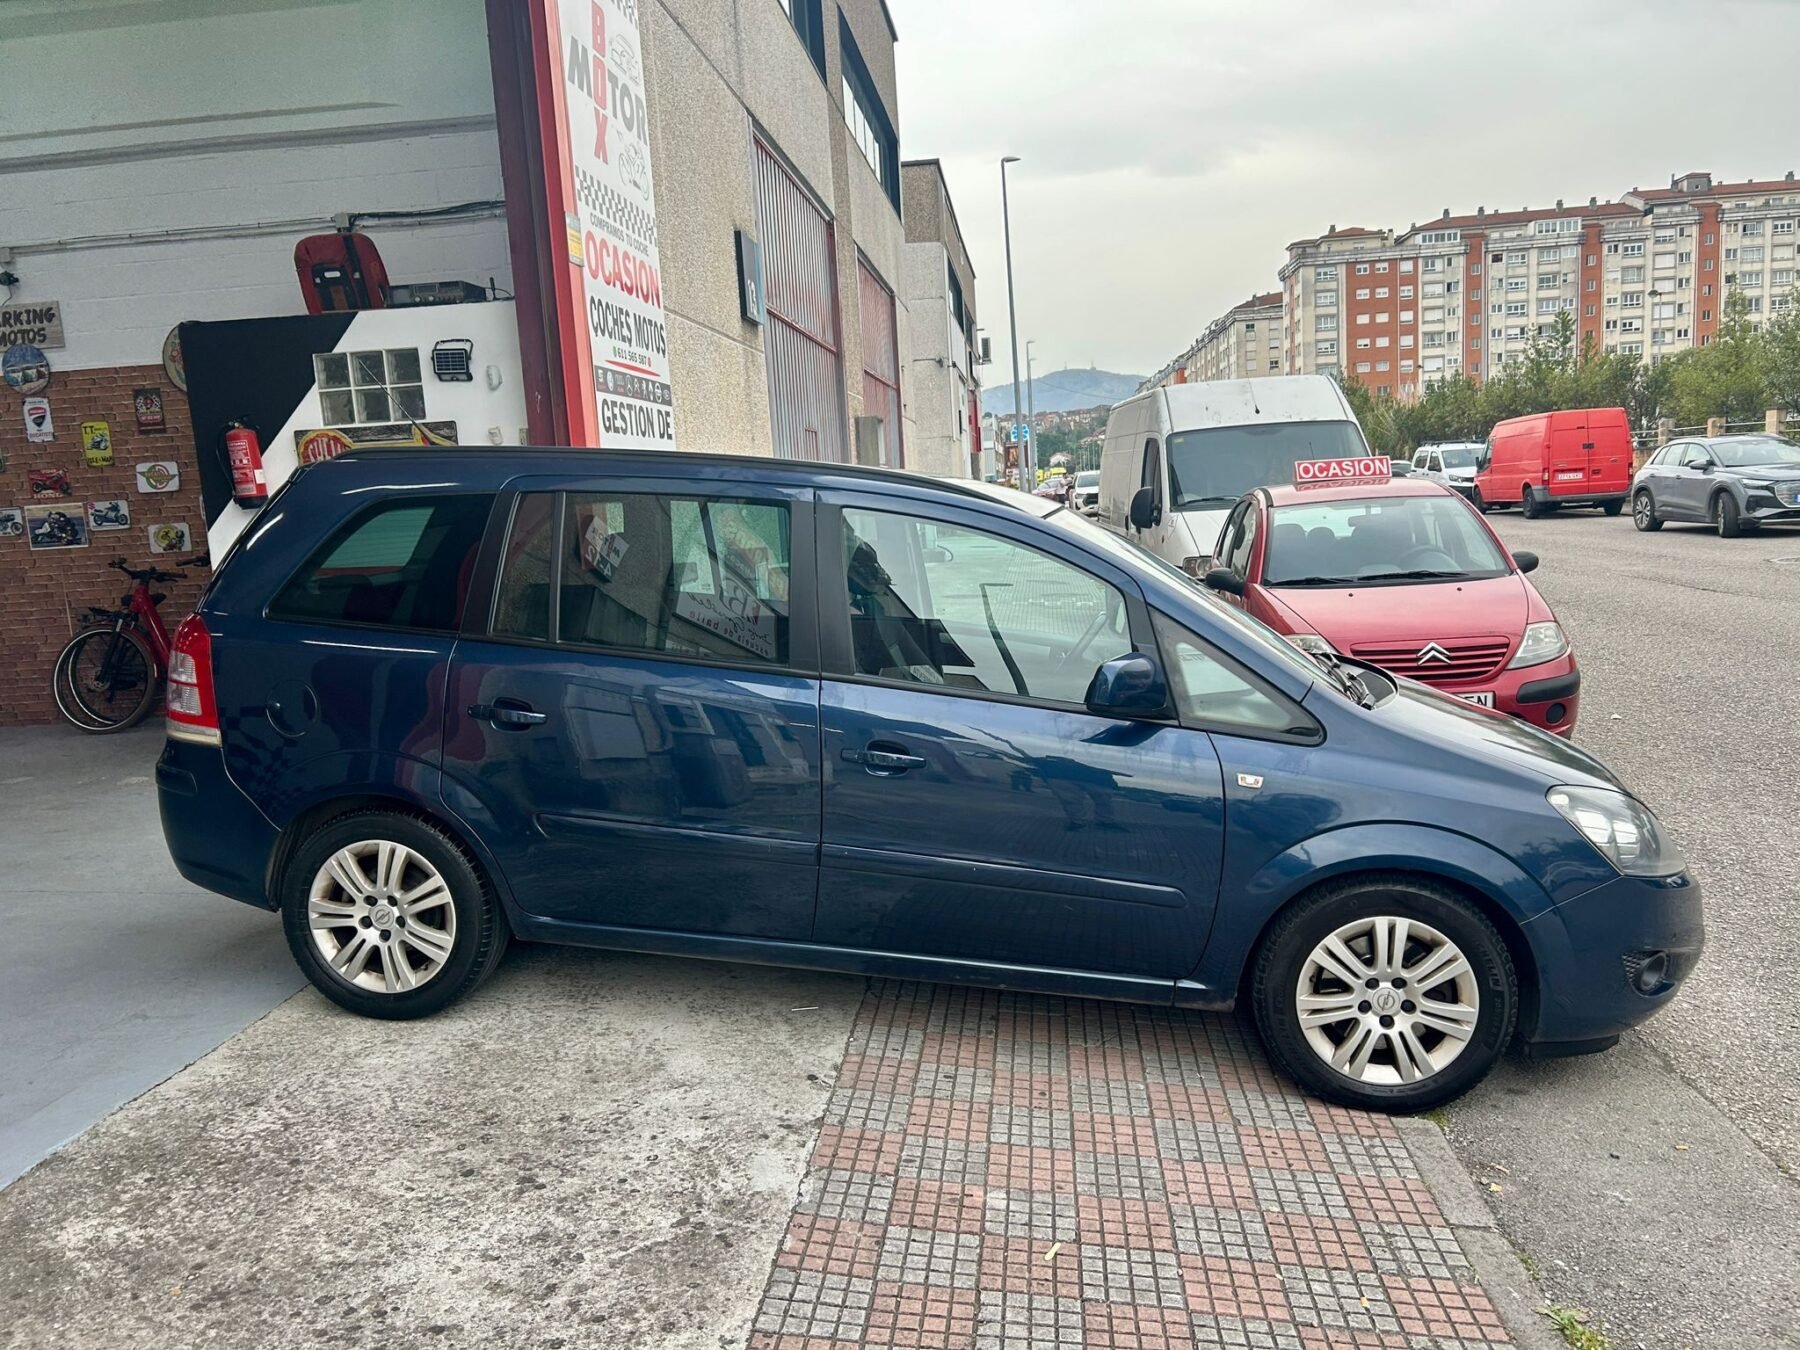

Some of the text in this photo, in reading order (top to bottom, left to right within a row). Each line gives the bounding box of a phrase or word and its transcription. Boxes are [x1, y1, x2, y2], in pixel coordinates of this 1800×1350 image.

[568, 35, 648, 146] MOTOR
[591, 1, 609, 165] BOX
[584, 230, 662, 309] OCASION
[590, 296, 666, 358] COCHES MOTOS
[601, 398, 673, 441] GESTION DE
[1299, 459, 1388, 478] OCASION
